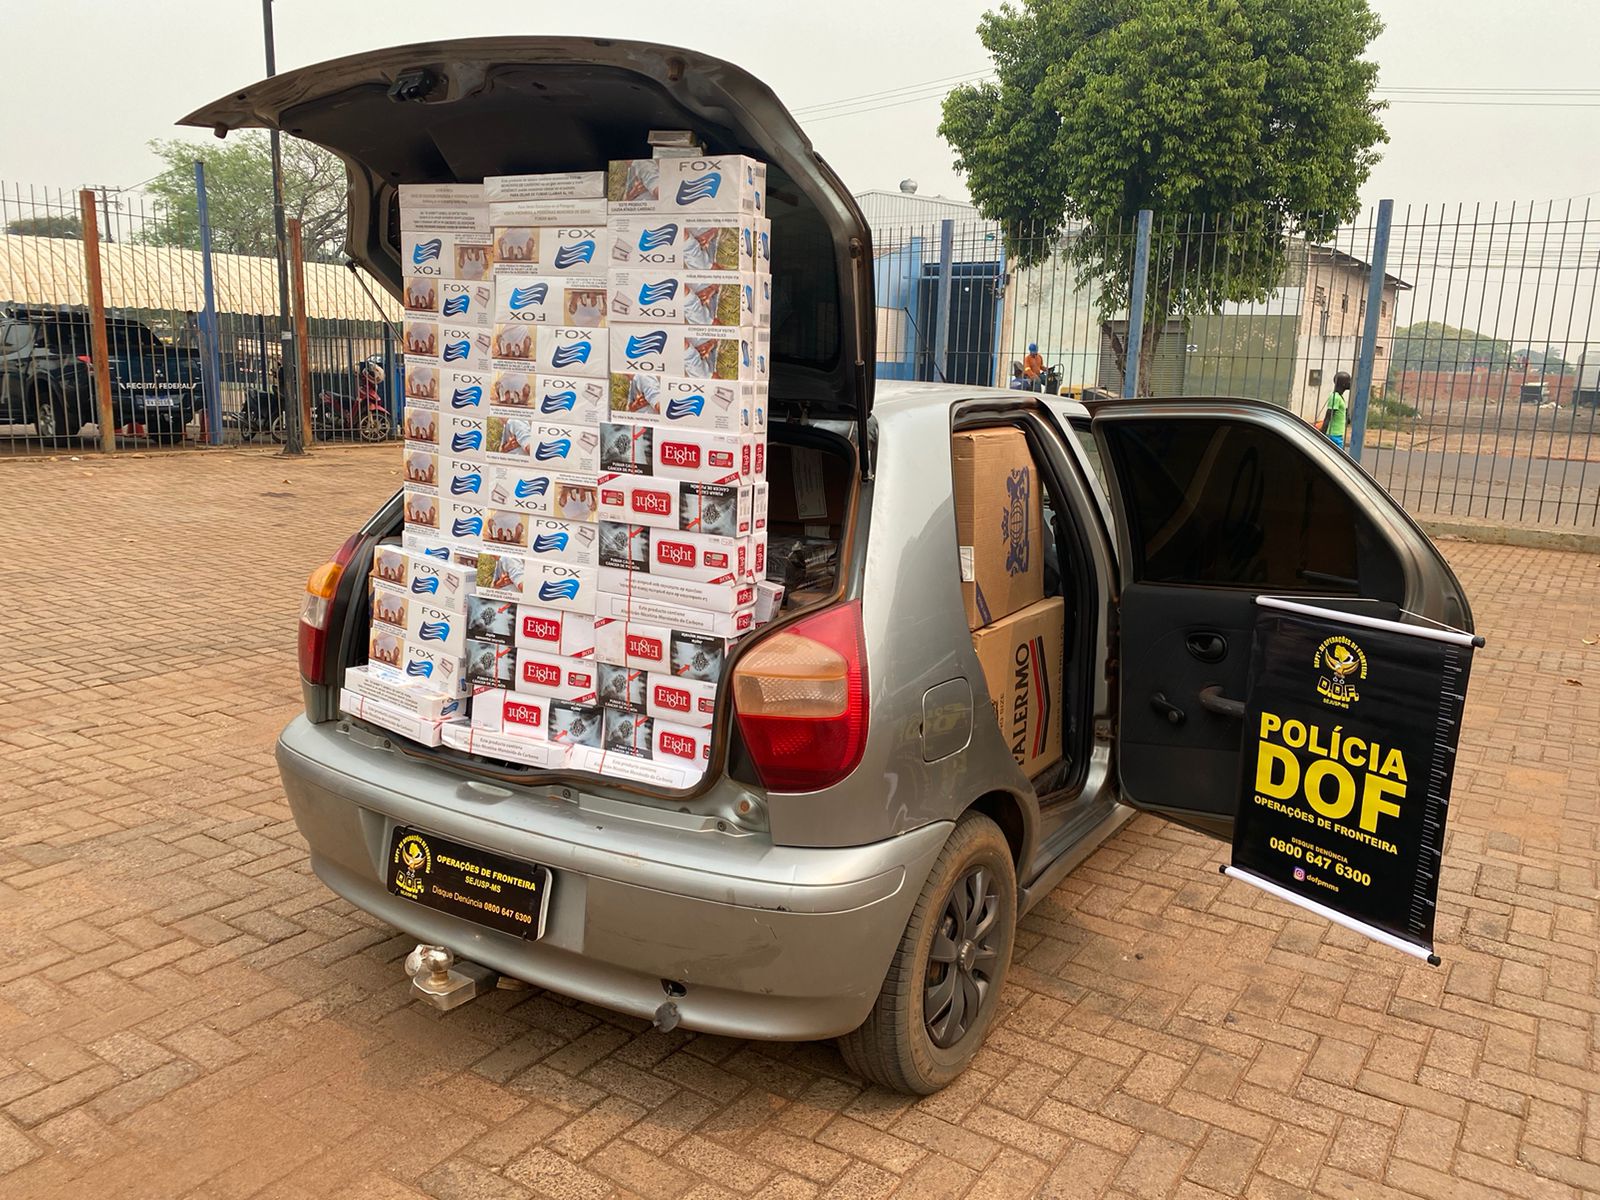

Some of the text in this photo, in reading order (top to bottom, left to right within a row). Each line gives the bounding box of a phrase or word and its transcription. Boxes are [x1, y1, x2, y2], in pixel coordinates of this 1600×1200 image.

[680, 160, 721, 171] FOX
[558, 230, 596, 238] FOX
[639, 254, 675, 263] FOX
[414, 266, 441, 275] FOX
[444, 284, 469, 293] FOX
[510, 312, 546, 322] FOX
[639, 308, 676, 318] FOX
[444, 330, 470, 339] FOX
[555, 330, 592, 340] FOX
[626, 361, 665, 371] FOX
[453, 374, 482, 385] FOX
[543, 380, 576, 390] FOX
[668, 383, 705, 393] FOX
[453, 418, 482, 429] FOX
[538, 427, 572, 437] FOX
[664, 445, 696, 464] Eight
[452, 461, 481, 473] FOX
[515, 499, 546, 511] FOX
[636, 493, 666, 512] Eight
[453, 504, 483, 516] FOX
[536, 520, 570, 531] FOX
[661, 544, 692, 563] Eight
[413, 563, 440, 576] FOX
[542, 565, 580, 578] FOX
[421, 607, 451, 622] FOX
[527, 620, 556, 637] Eight
[409, 646, 434, 661] FOX
[630, 640, 659, 658] Eight
[527, 666, 557, 682] Eight
[659, 689, 687, 707] Eight
[508, 707, 537, 724] Eight
[663, 736, 692, 754] Eight
[1259, 712, 1408, 781] POLÍCIA
[1255, 740, 1406, 833] DOF
[1254, 796, 1398, 855] OPERAÇÕES DE FRONTEIRA
[1291, 837, 1348, 864] DISQUE DENÚNCIA
[1270, 837, 1371, 887] 0800 647 6300
[437, 854, 536, 891] OPERAÇÕES DE FRONTEIRA
[465, 876, 501, 893] SEJUSP-MS
[1307, 873, 1339, 892] dofpmms
[433, 884, 531, 924] Disque Denúncia 0800 647 6300
